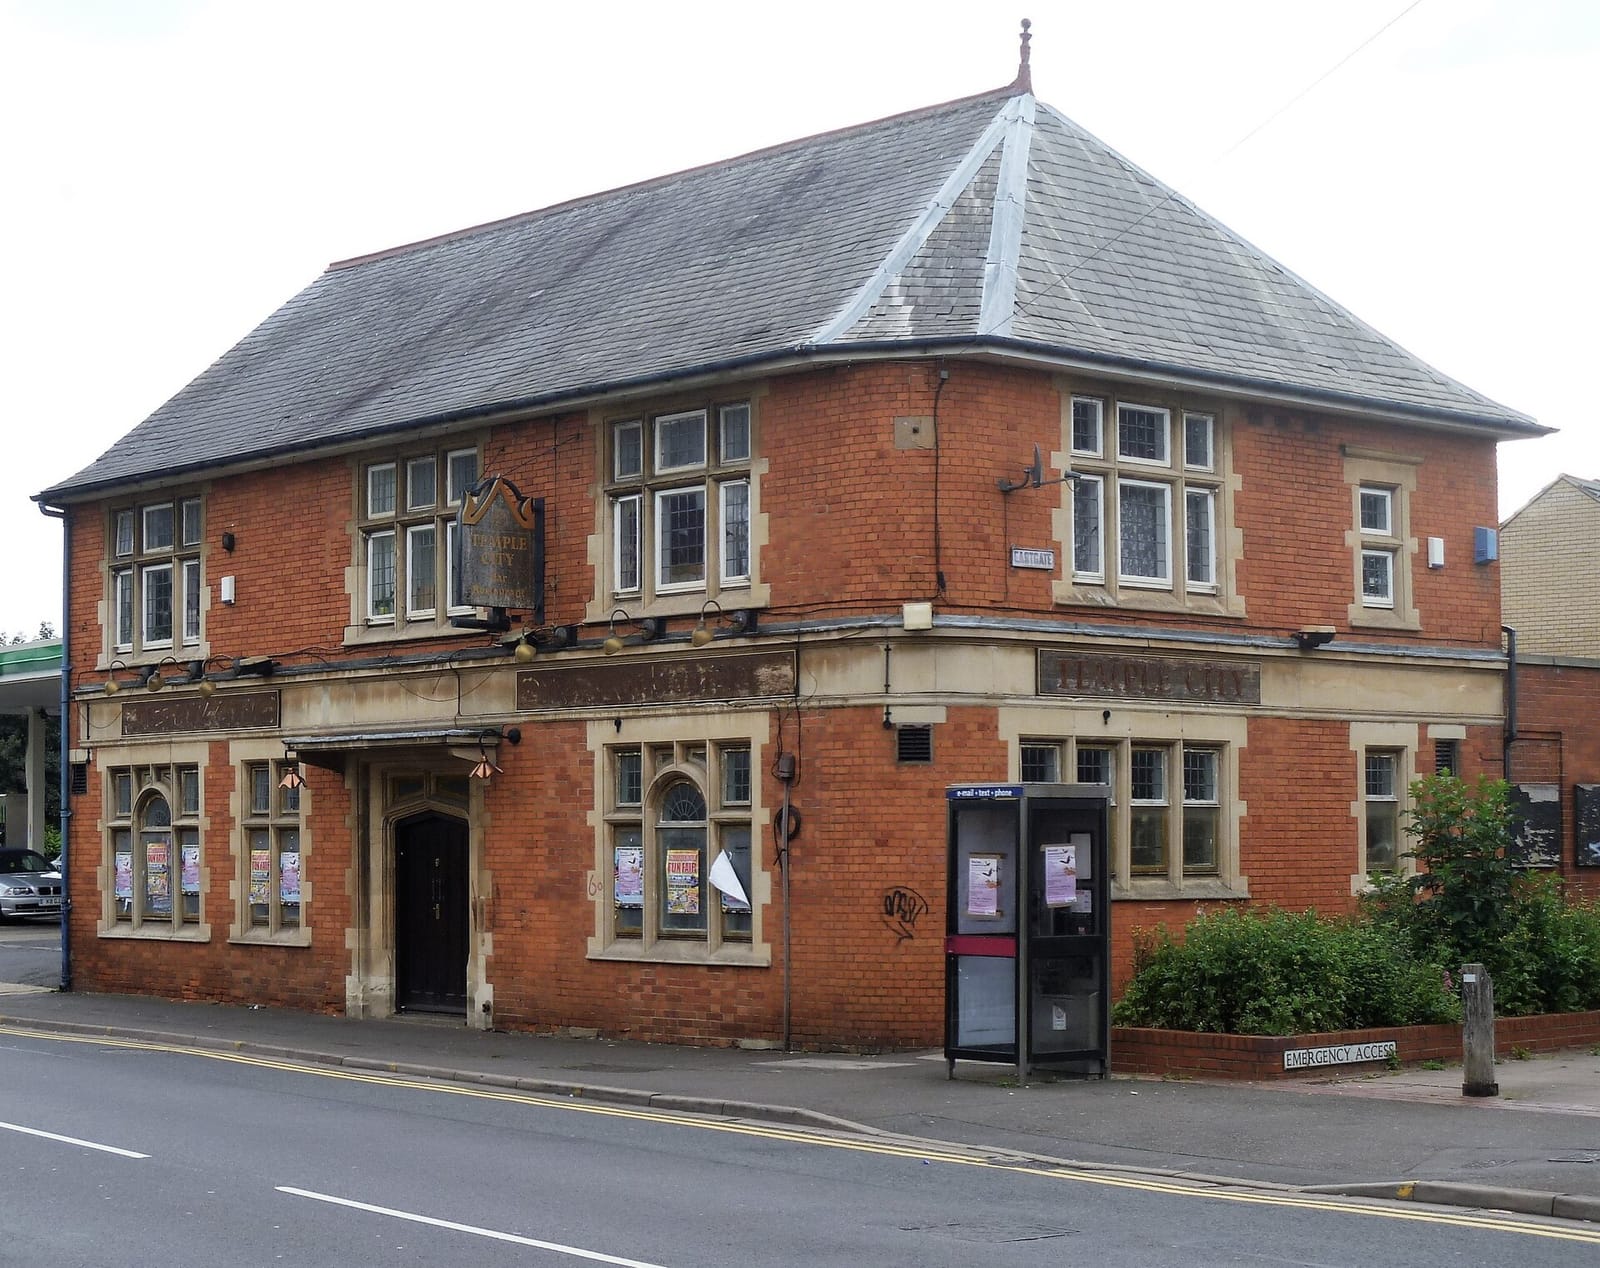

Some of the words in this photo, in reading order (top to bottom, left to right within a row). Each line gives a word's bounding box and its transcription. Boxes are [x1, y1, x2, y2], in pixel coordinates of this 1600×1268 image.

[471, 533, 528, 551] TEMPLE
[480, 551, 515, 567] CITY
[1058, 658, 1171, 693] TEMPLE
[1184, 665, 1245, 698] CITY
[957, 789, 975, 797] e-mail
[994, 788, 1013, 798] phone
[667, 862, 681, 874] FUN
[682, 862, 697, 874] FAIR
[1286, 1047, 1351, 1067] EMERGENCY
[1355, 1043, 1394, 1061] ACCESS
